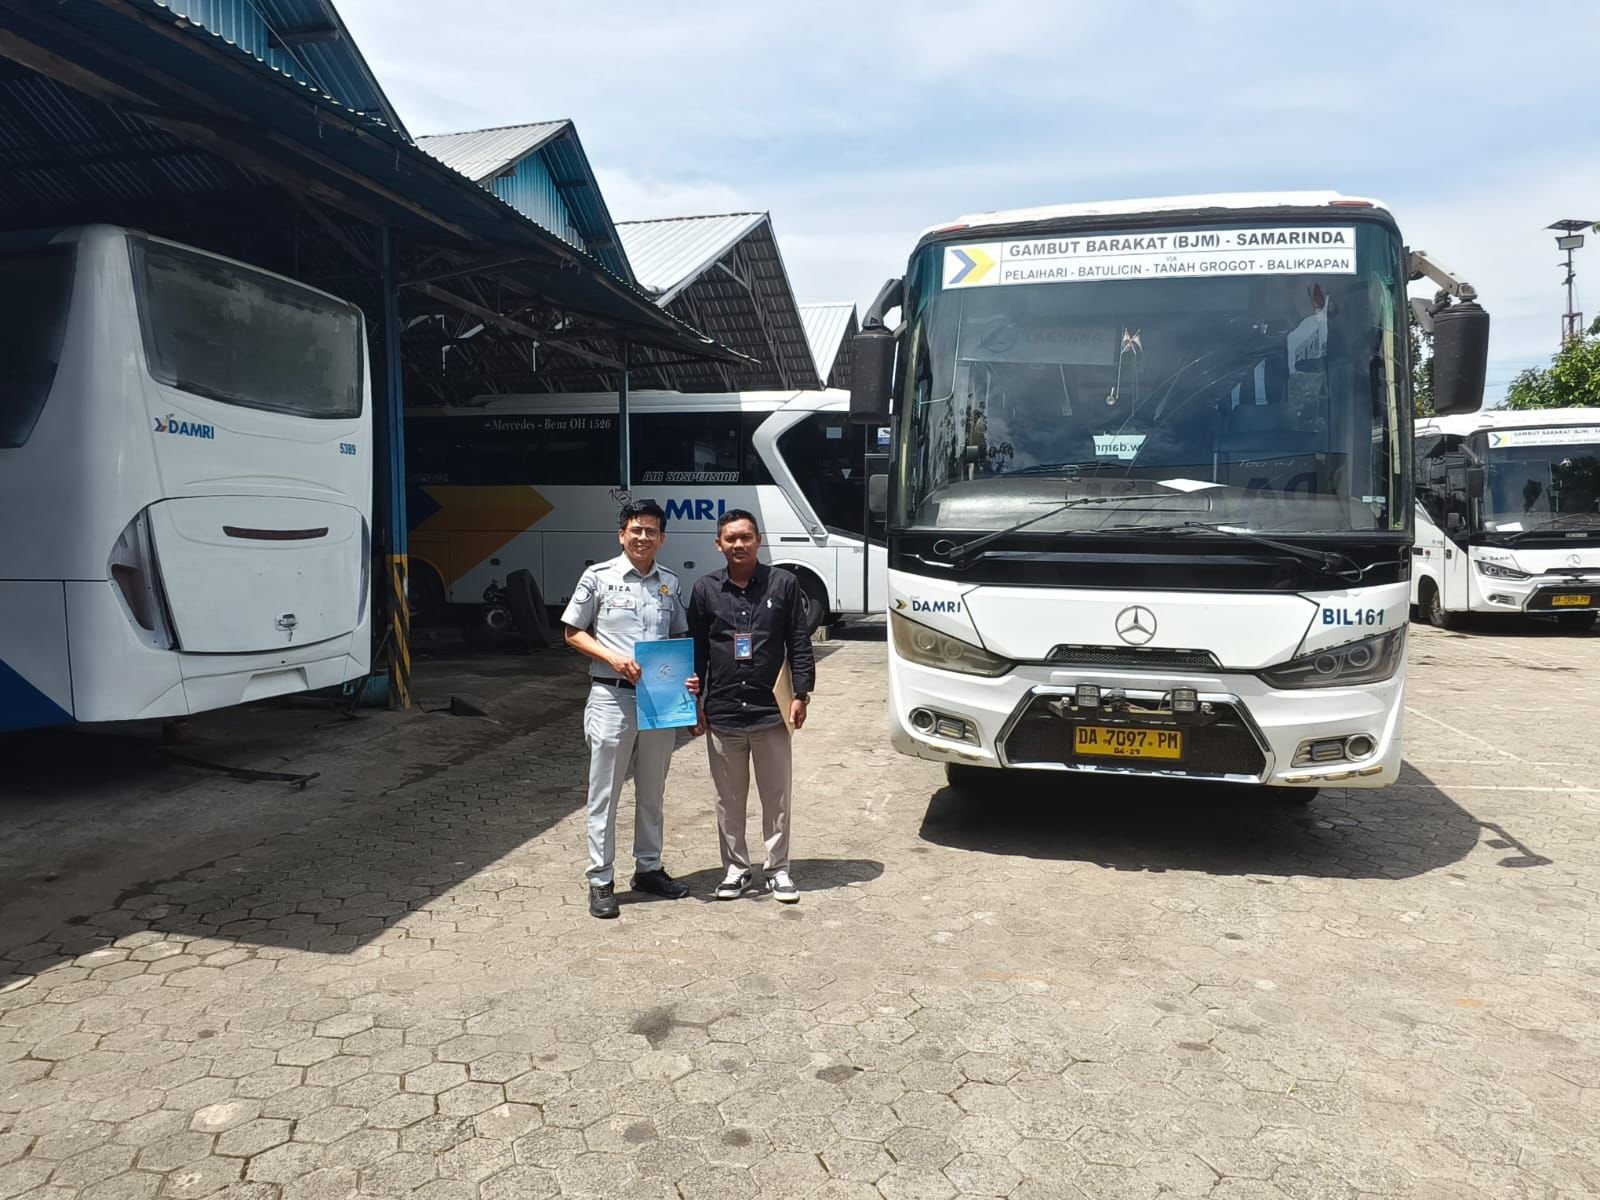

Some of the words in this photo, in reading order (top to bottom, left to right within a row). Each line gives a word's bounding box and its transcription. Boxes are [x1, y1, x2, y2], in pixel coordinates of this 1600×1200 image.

[1009, 240, 1080, 257] GAMBUT
[1086, 236, 1168, 253] BARAKAT
[1173, 234, 1220, 250] (BJM)
[1236, 231, 1346, 246] SAMARINDA
[1005, 267, 1068, 281] PELAIHARI
[1078, 264, 1142, 277] BATULICIN
[1153, 262, 1195, 274] TANAH
[1200, 260, 1256, 272] GROGOT
[1267, 258, 1349, 271] BALIKPAPAN
[168, 419, 215, 440] DAMRI
[493, 418, 536, 431] Mercedes
[544, 418, 567, 430] Benz
[569, 418, 586, 429] OH
[642, 471, 664, 482] AIR
[666, 471, 740, 482] SUSPENSION
[665, 498, 726, 521] MRI
[608, 584, 631, 592] RIZA
[912, 600, 961, 613] DAMRI
[1322, 608, 1385, 626] BIL161
[1077, 727, 1098, 745] DA
[1106, 729, 1148, 748] 7097
[1157, 732, 1178, 749] PM
